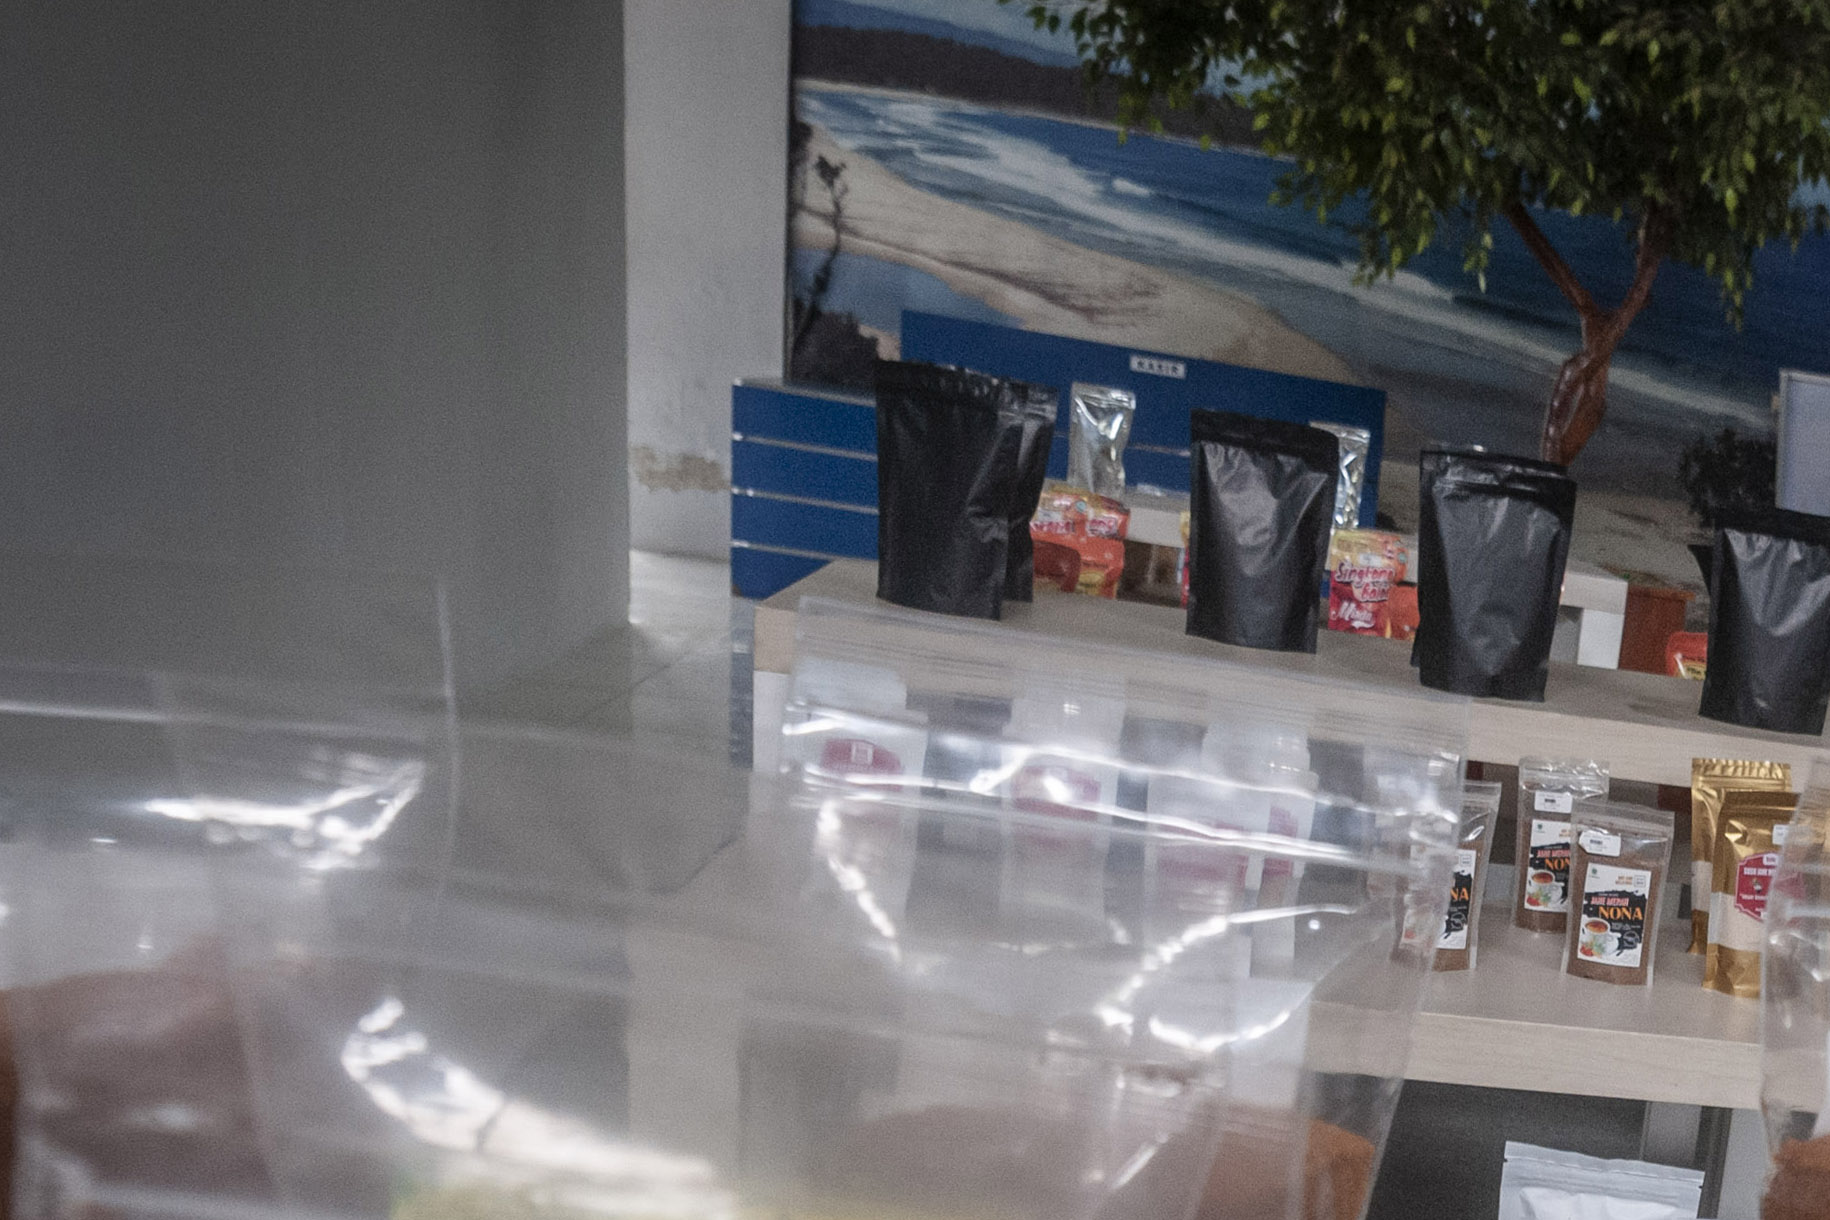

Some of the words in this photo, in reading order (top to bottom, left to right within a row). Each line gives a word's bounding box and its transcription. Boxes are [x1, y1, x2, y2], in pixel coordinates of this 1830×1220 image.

[1544, 857, 1571, 870] NON
[1450, 887, 1469, 900] NA
[1599, 906, 1643, 920] NONA
